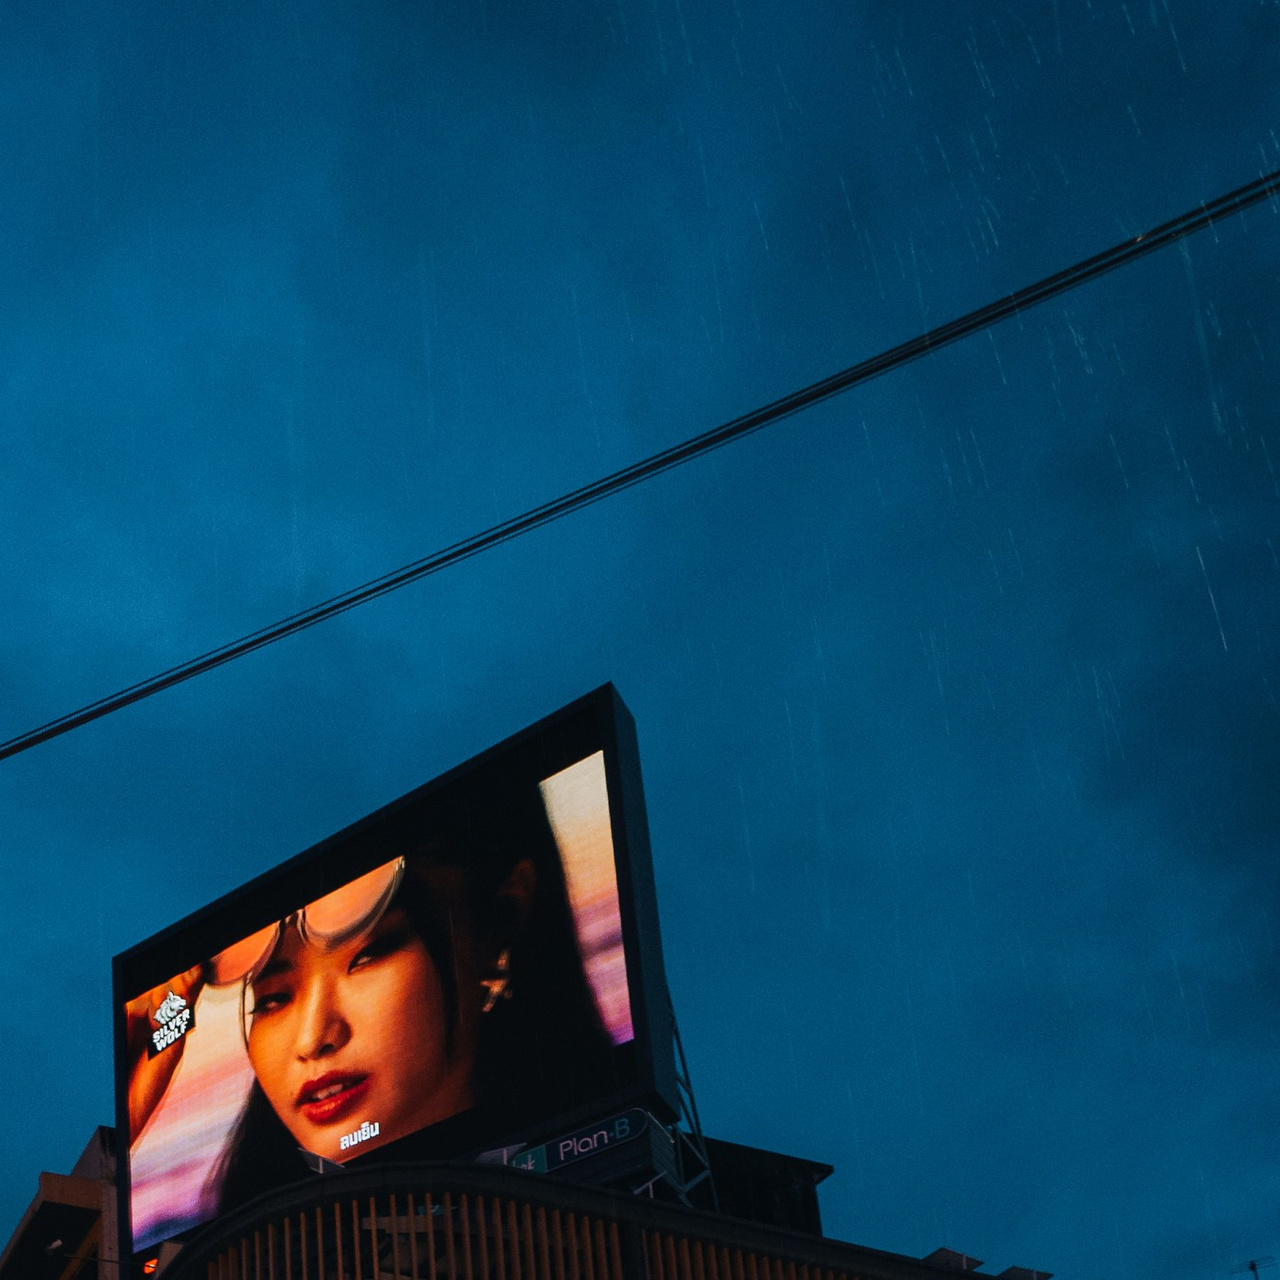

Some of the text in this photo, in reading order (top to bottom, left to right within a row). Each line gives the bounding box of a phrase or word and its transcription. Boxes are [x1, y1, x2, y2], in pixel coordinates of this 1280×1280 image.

[152, 1009, 190, 1043] SILVER
[156, 1021, 188, 1051] WOLF
[339, 1121, 380, 1150] ลมเย็น
